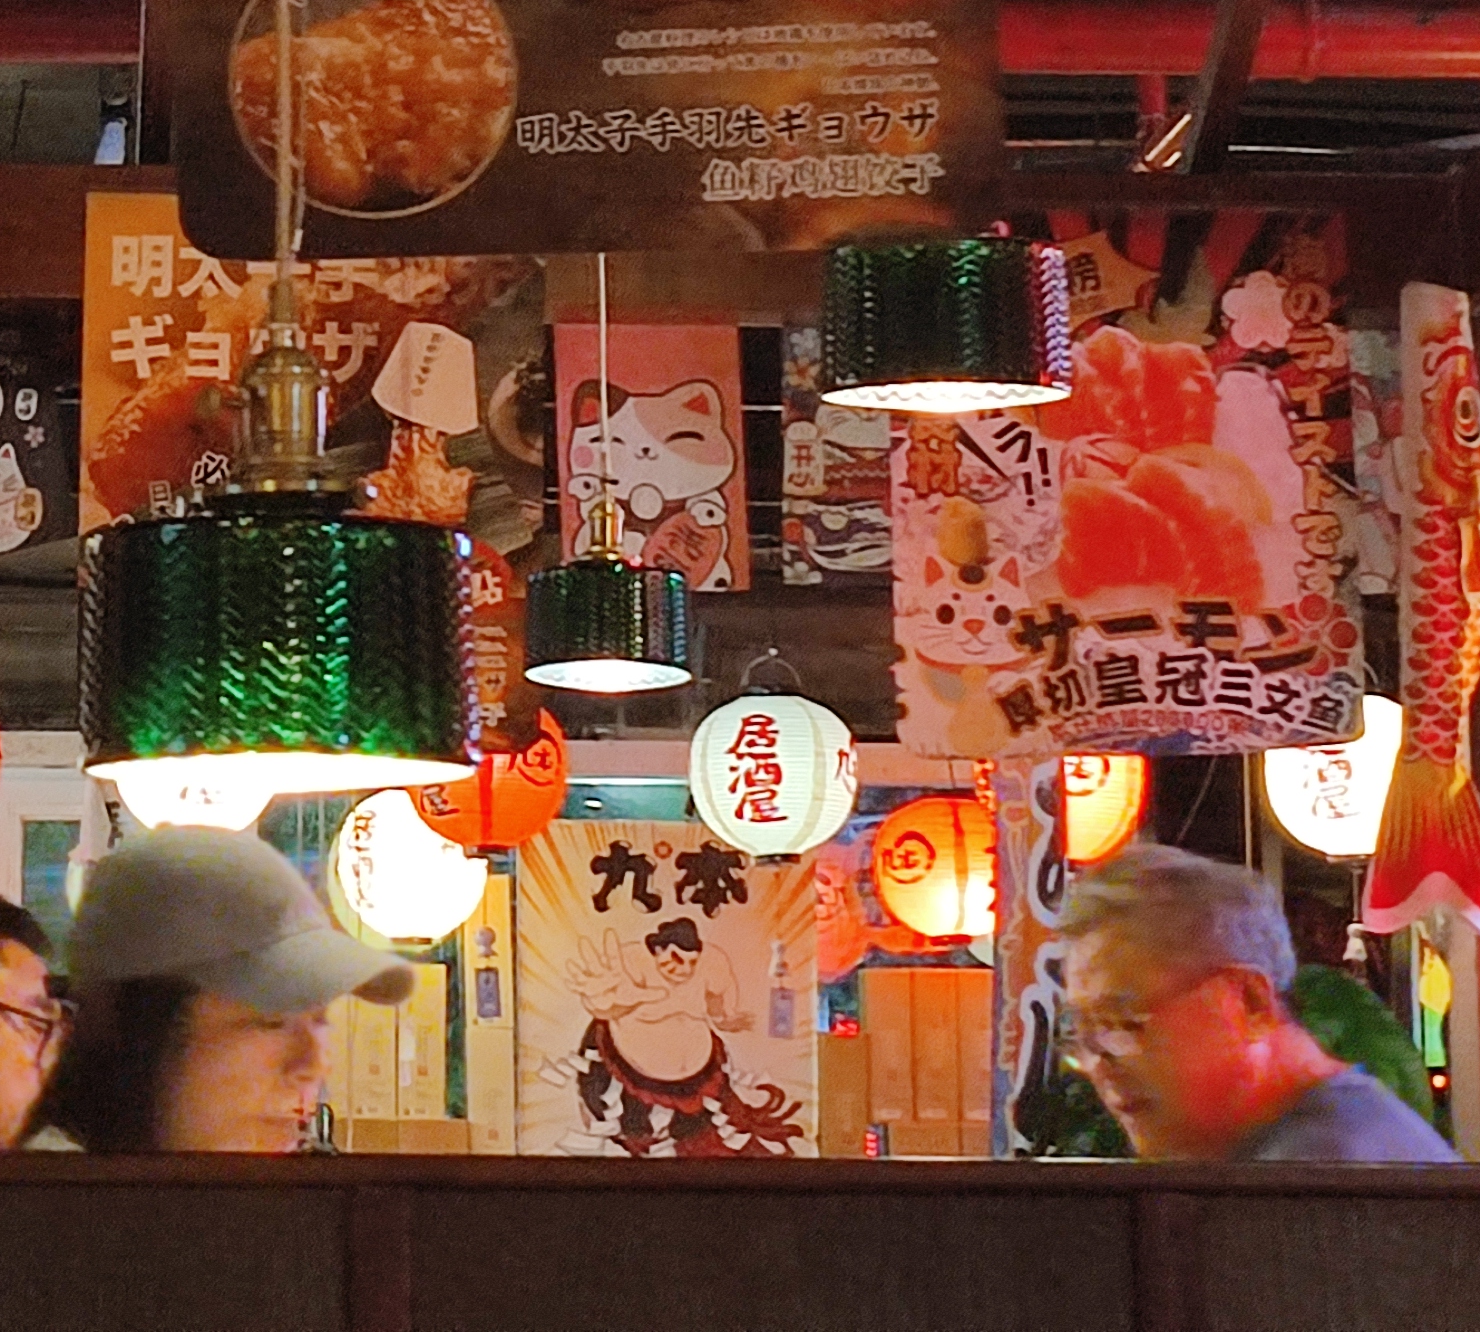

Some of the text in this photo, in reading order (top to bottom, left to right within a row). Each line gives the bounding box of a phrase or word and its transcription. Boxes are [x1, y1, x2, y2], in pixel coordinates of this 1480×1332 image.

[727, 714, 789, 823] 居酒屋
[590, 839, 748, 919] 九本
